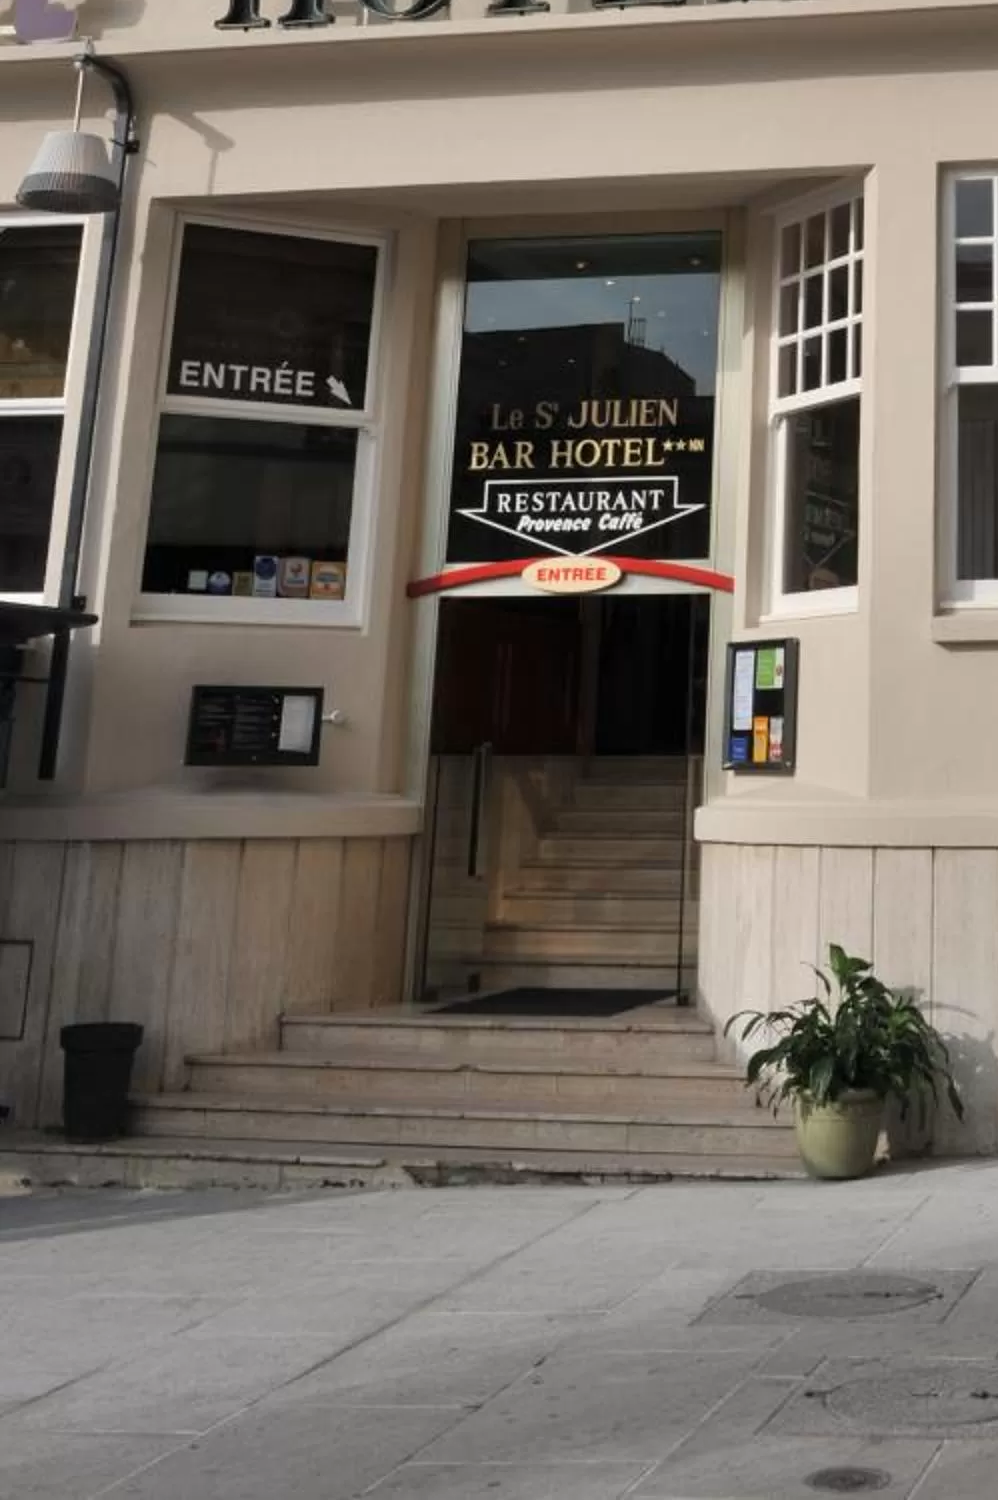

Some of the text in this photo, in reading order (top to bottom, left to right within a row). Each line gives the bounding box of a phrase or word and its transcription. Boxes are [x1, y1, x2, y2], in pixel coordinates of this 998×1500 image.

[179, 360, 315, 398] ENTRÉE
[492, 403, 523, 430] Le
[567, 399, 679, 428] JULIEN
[467, 440, 536, 470] BAR
[548, 437, 666, 469] HOTEL
[497, 489, 665, 513] RESTAURANT
[517, 514, 592, 532] Provence
